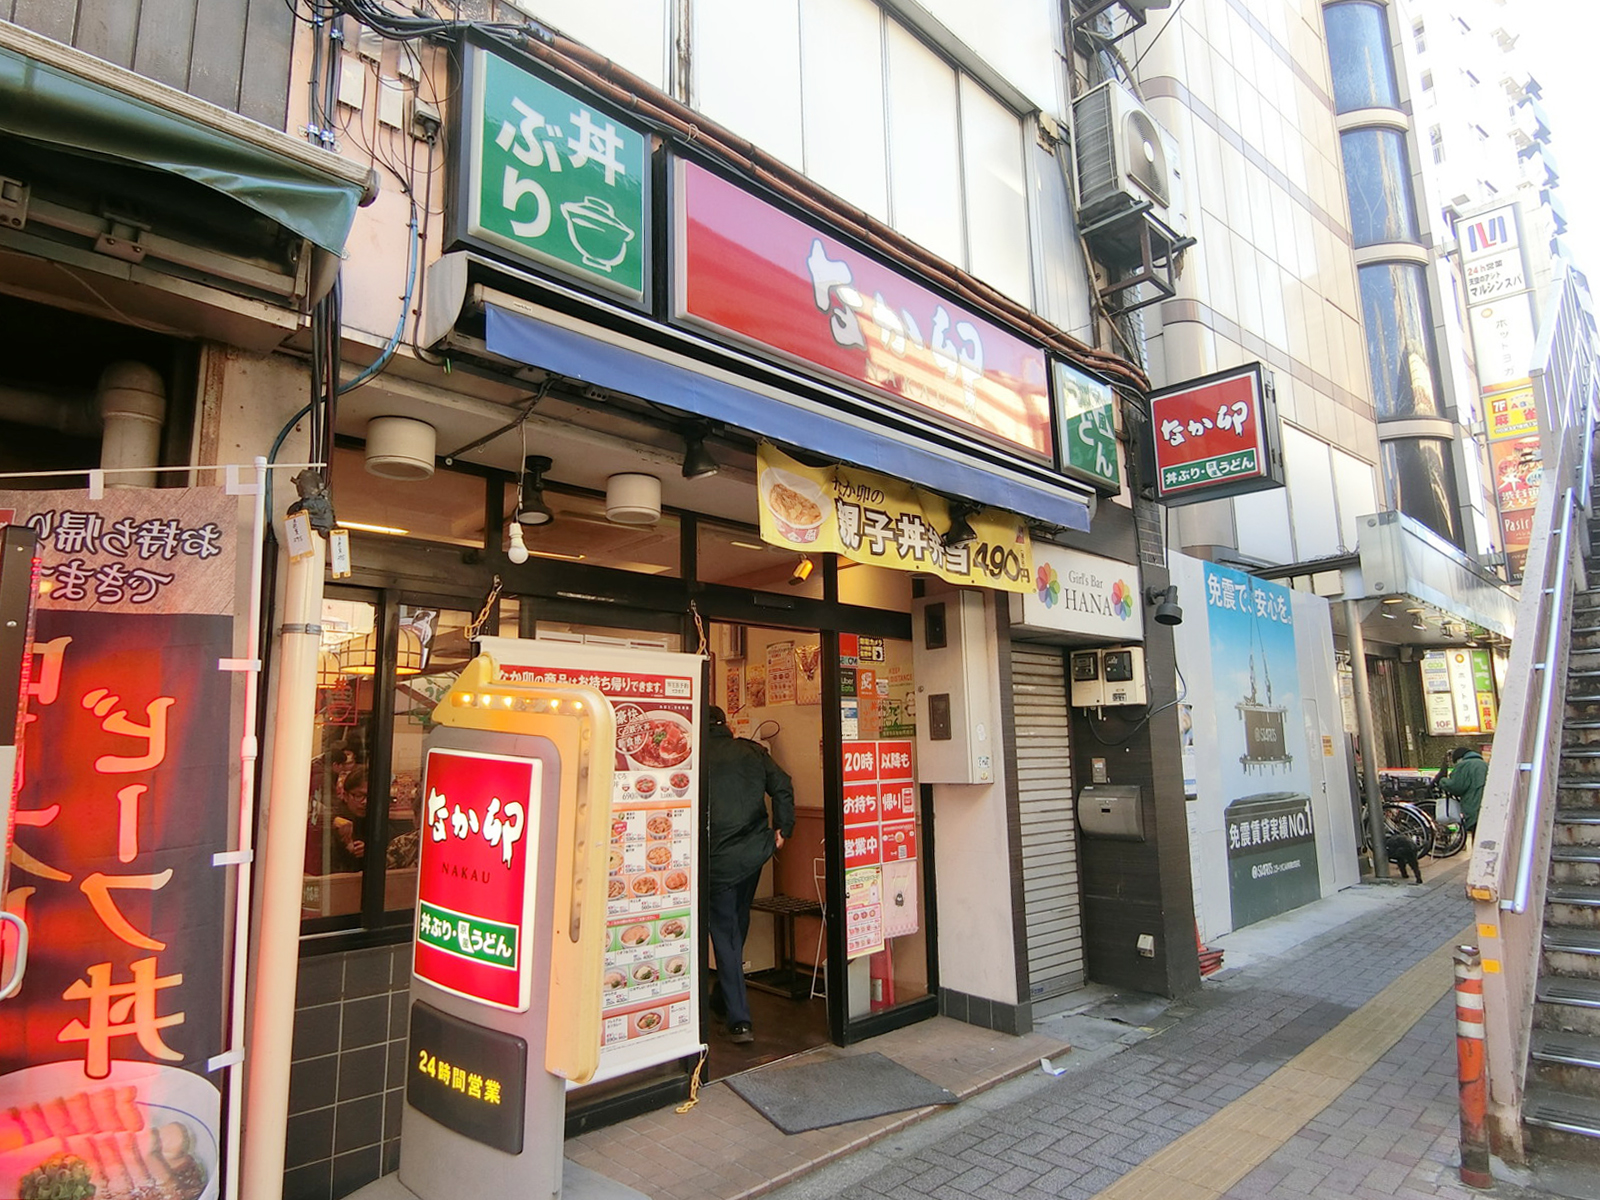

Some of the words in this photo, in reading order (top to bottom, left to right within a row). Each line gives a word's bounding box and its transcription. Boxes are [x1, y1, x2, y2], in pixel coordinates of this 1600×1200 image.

[806, 237, 984, 421] なか卯
[866, 357, 946, 408] NAKAU
[1493, 400, 1506, 412] 7F
[1160, 401, 1248, 447] なか卯
[1505, 518, 1529, 532] Pasir
[972, 542, 1031, 584] 490円
[1068, 570, 1090, 586] Girl's
[1091, 574, 1104, 588] Bar
[1064, 588, 1113, 617] HANA
[1207, 573, 1293, 625] 免震で、安心を。
[841, 676, 854, 685] Uber
[1435, 720, 1451, 728] 10F
[844, 752, 874, 772] 20時
[881, 752, 910, 769] 以降も
[843, 795, 877, 814] お持ち
[882, 793, 901, 811] 帰り
[428, 787, 525, 870] なか卯
[1229, 800, 1313, 850] 免震賃貸実績NO.1
[844, 835, 878, 858] 営業中
[441, 863, 491, 884] NAKAU
[418, 1050, 501, 1105] 24時間営業
